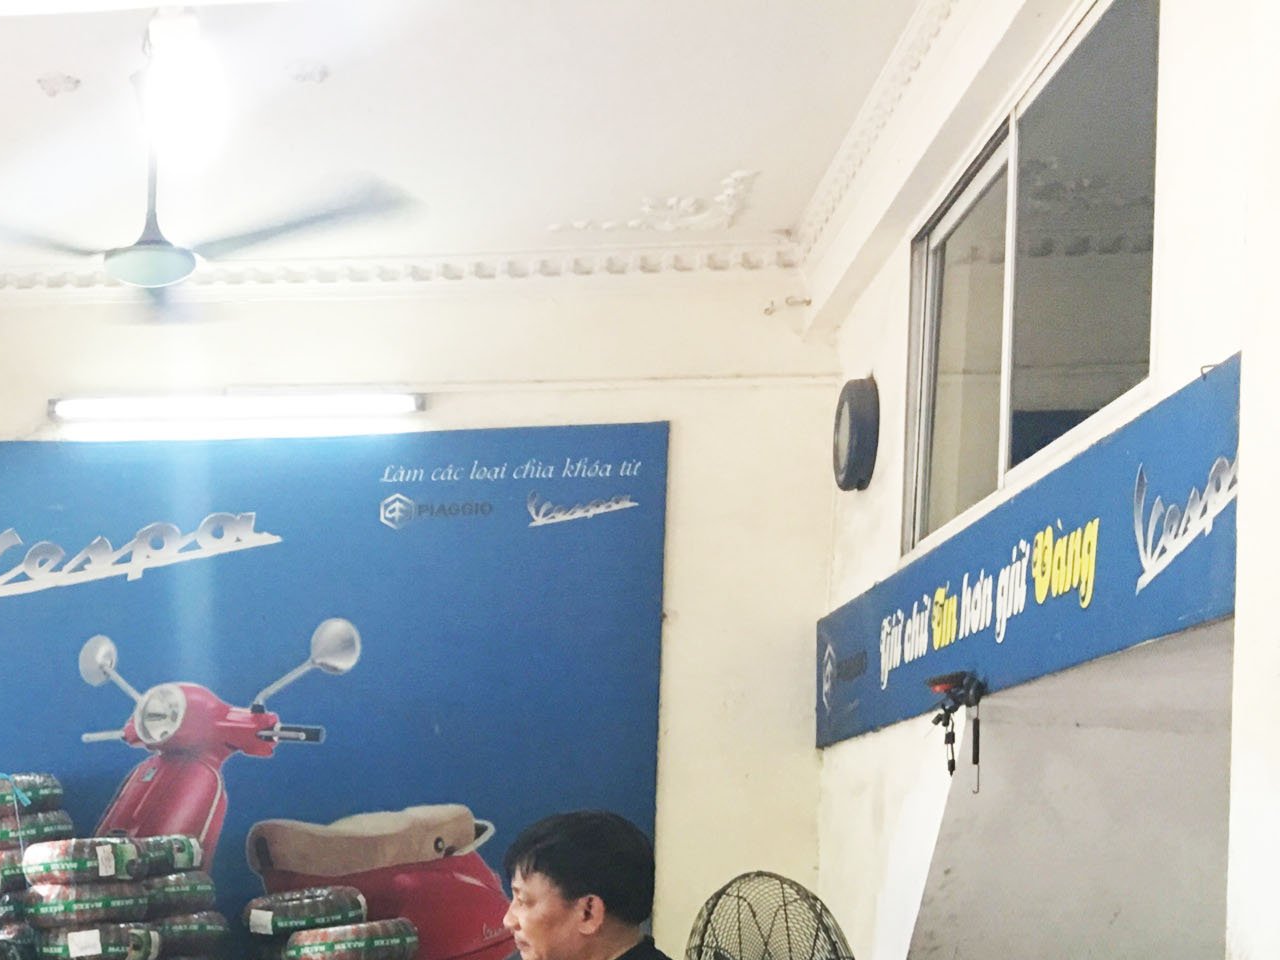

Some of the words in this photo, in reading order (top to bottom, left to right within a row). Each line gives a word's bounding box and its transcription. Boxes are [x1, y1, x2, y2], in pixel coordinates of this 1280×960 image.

[379, 463, 425, 483] Làm
[431, 464, 461, 482] các
[416, 501, 493, 519] PIAGGIO
[527, 489, 640, 527] Vespa
[1031, 516, 1101, 610] Vàng
